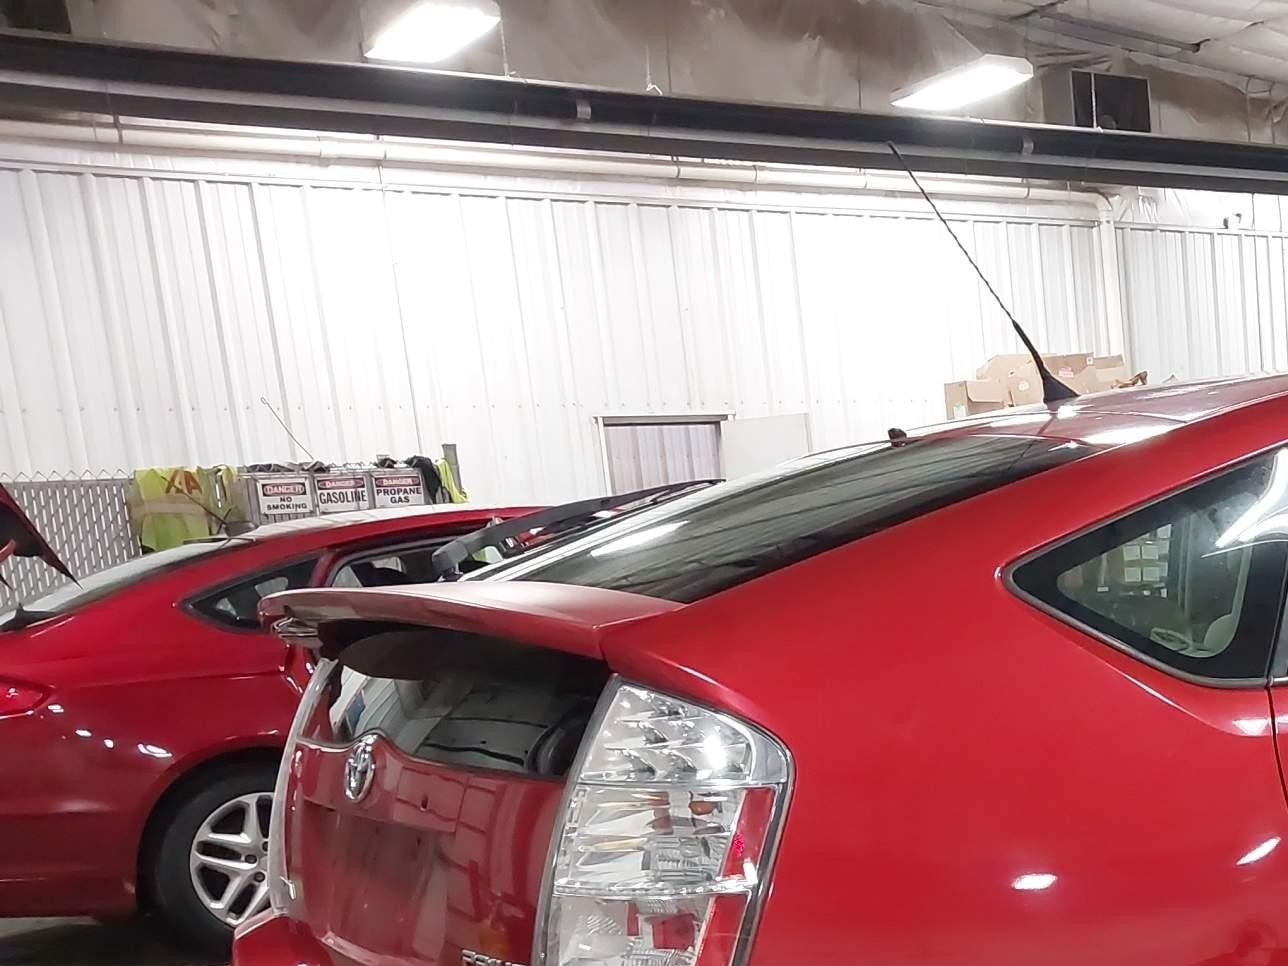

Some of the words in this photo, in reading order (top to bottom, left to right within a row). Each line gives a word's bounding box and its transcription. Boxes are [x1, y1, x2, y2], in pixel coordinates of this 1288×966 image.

[266, 485, 303, 495] DANGER
[376, 486, 423, 497] PROPANE
[279, 495, 293, 503] NO
[319, 489, 367, 505] GASOLINE
[389, 496, 411, 504] GAS
[266, 502, 308, 511] SMOKING
